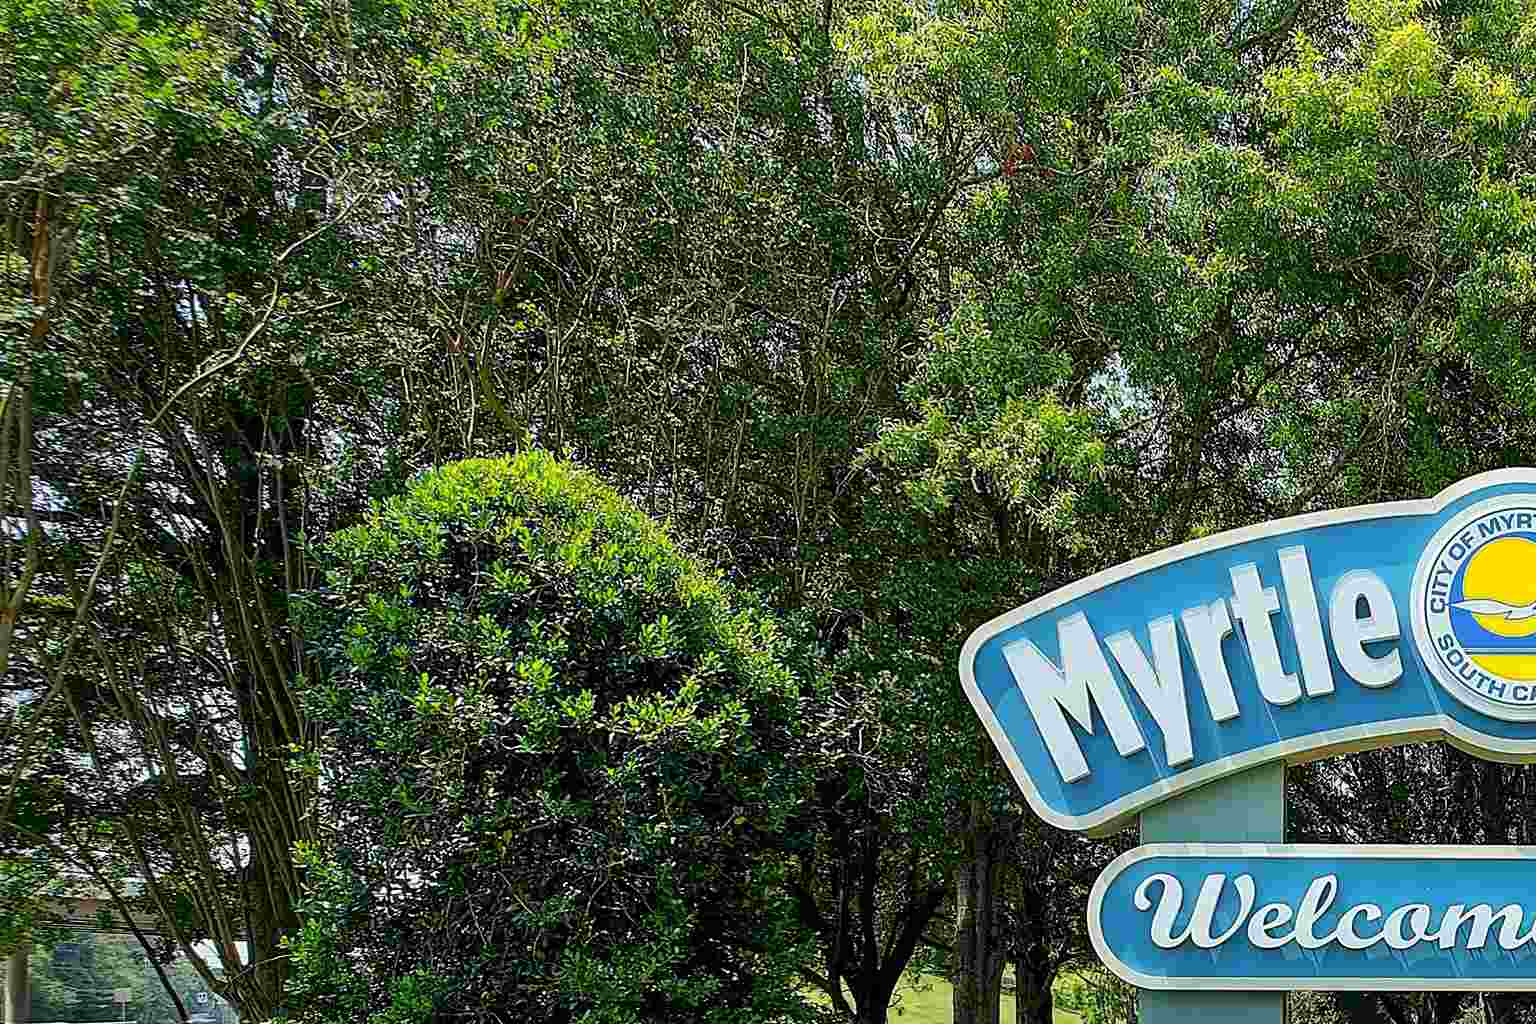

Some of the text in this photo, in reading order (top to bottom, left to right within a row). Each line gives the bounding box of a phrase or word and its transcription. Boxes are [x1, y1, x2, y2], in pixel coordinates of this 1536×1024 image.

[1430, 562, 1453, 614] CITY
[1448, 533, 1474, 559] OF
[1003, 545, 1404, 784] Myrtle
[1437, 633, 1505, 699] SOUTH
